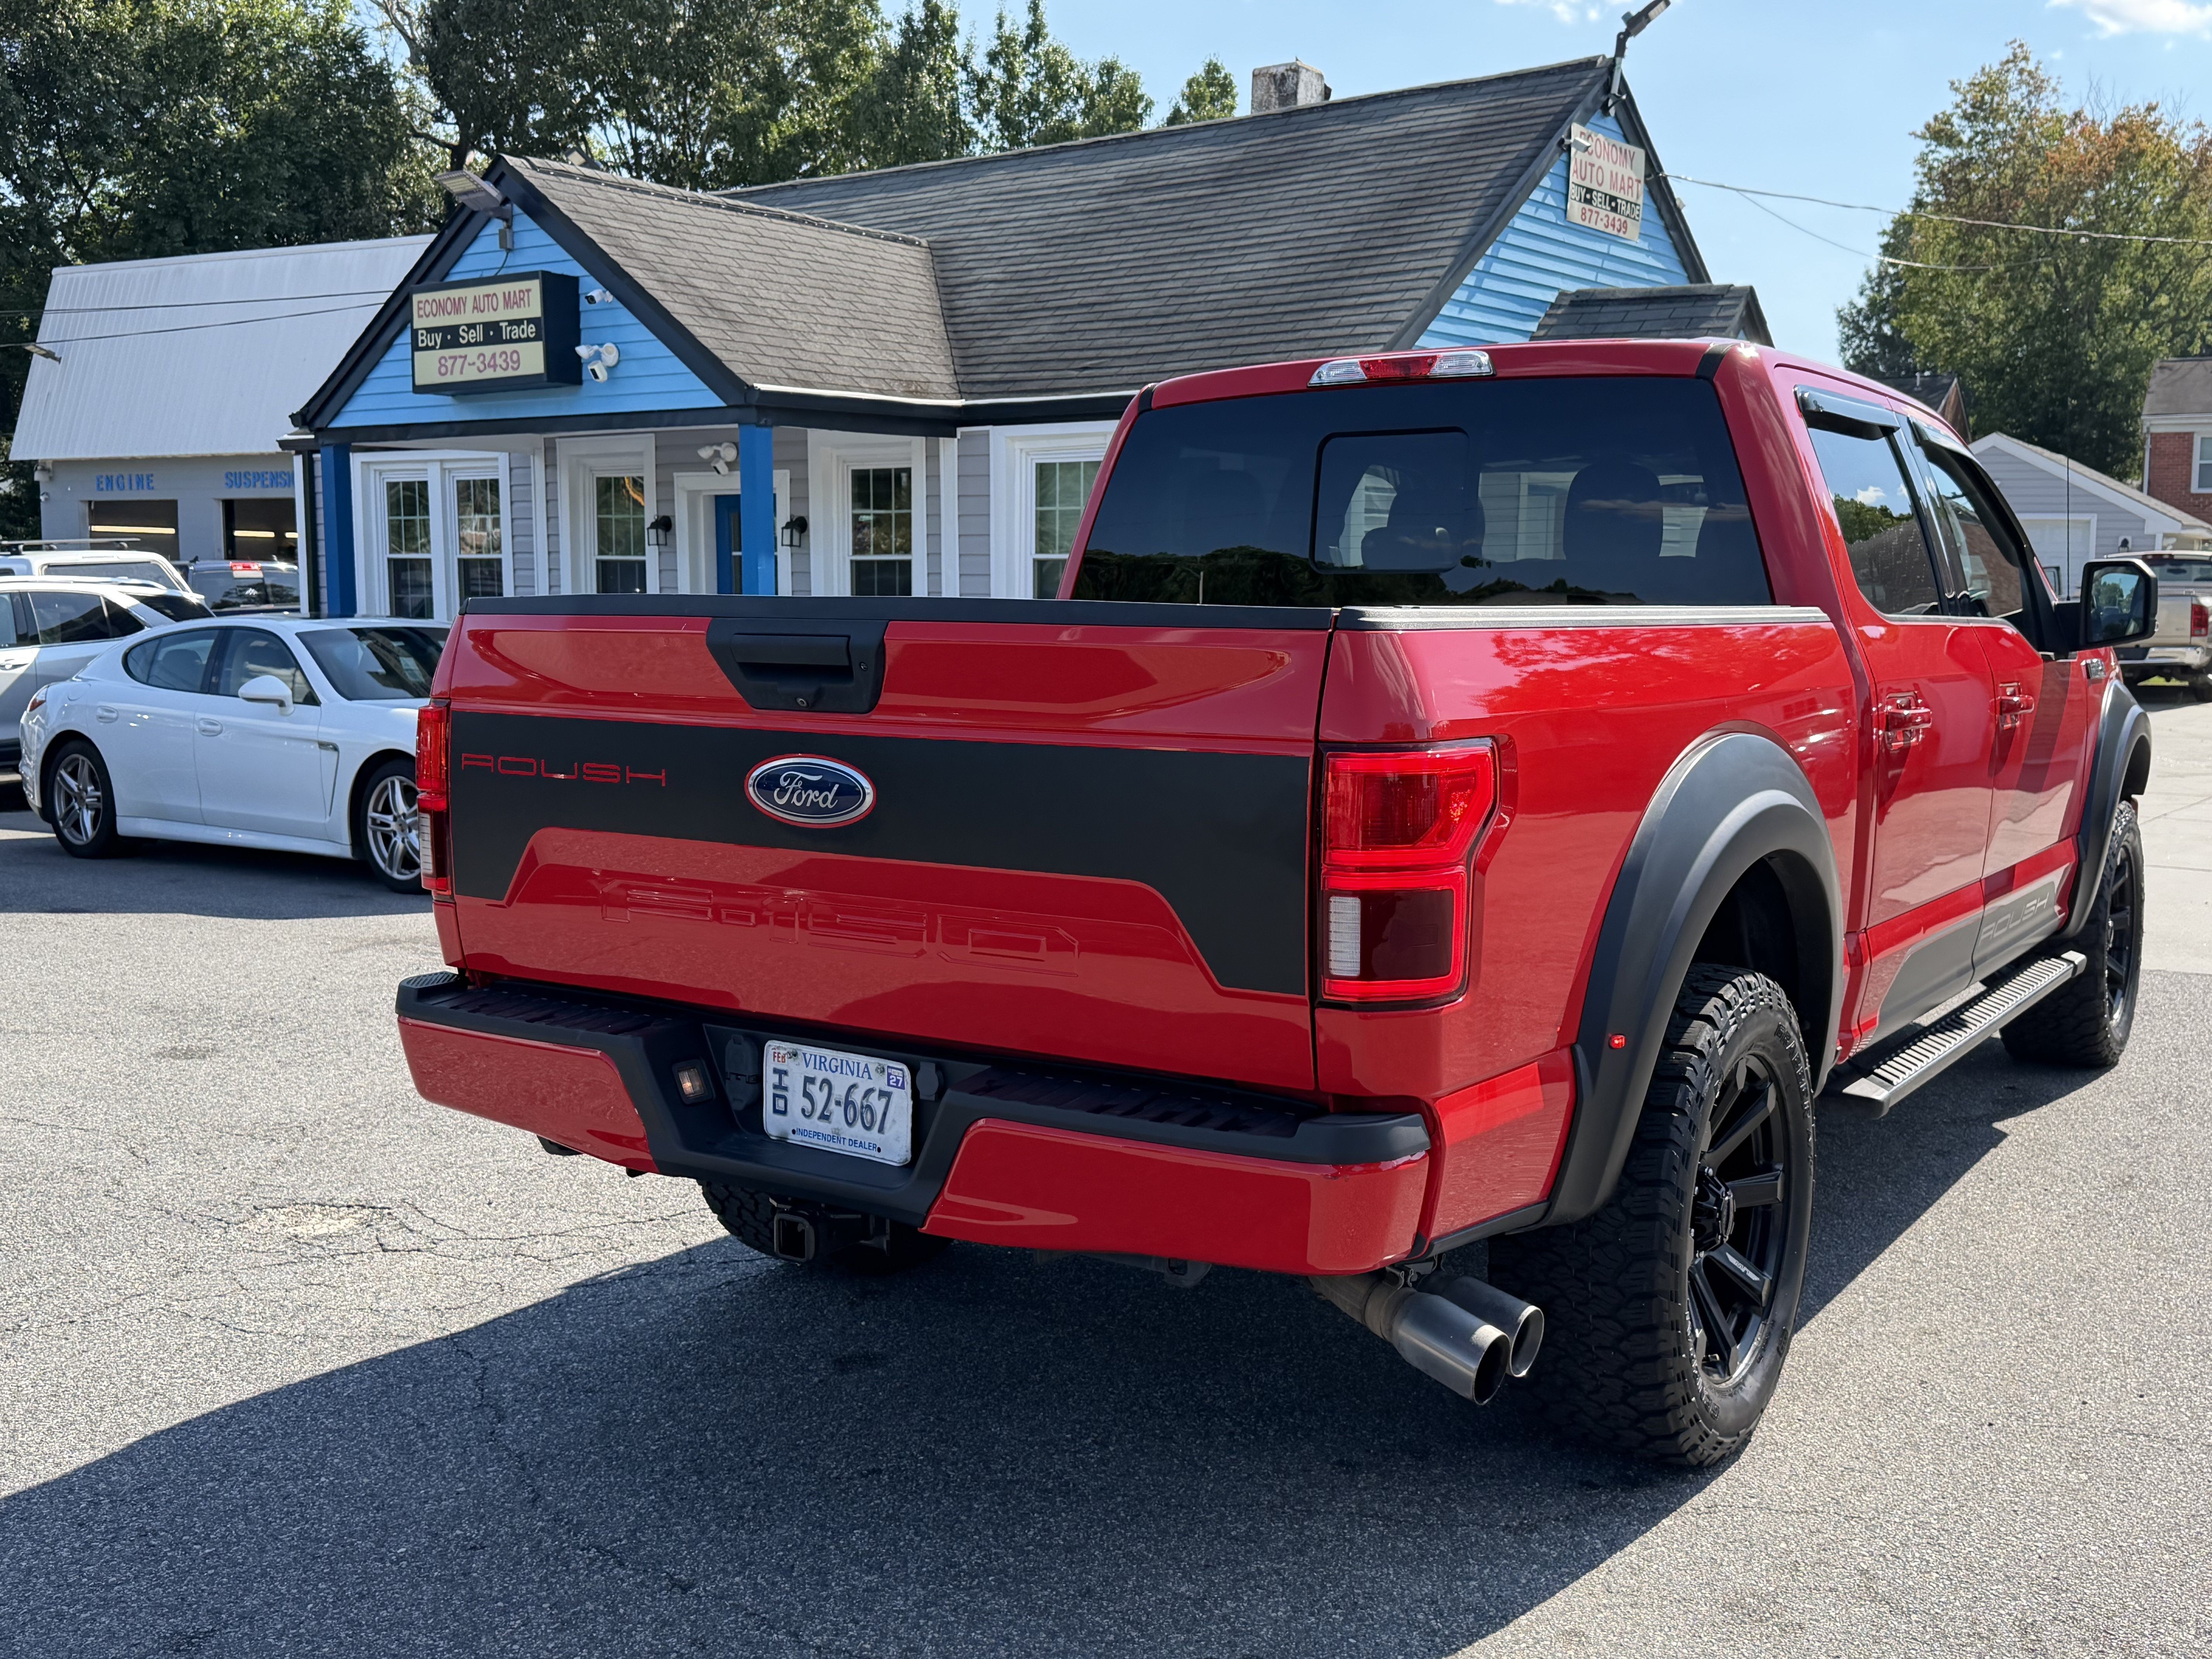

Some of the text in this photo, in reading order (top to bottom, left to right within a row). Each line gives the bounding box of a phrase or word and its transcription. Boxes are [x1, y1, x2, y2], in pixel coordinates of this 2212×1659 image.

[1572, 157, 1641, 200] AUTO MART
[1571, 183, 1640, 220] BUY SELL TRADE
[1580, 207, 1628, 234] 877-3439
[417, 289, 532, 319] ECONOMY AUTO MART
[418, 320, 536, 349] Buy Sell Trade
[438, 350, 521, 377] 877-3439
[96, 473, 155, 491] ENGINE
[461, 753, 666, 787] ROUSH
[774, 770, 840, 809] Ford
[1979, 892, 2049, 946] ROUSH
[773, 1051, 786, 1063] FEB
[802, 1052, 873, 1080] VIRGINIA
[890, 1075, 903, 1087] 27
[801, 1075, 893, 1135] 52-667
[796, 1127, 877, 1152] INDEPENDENT DEALER
